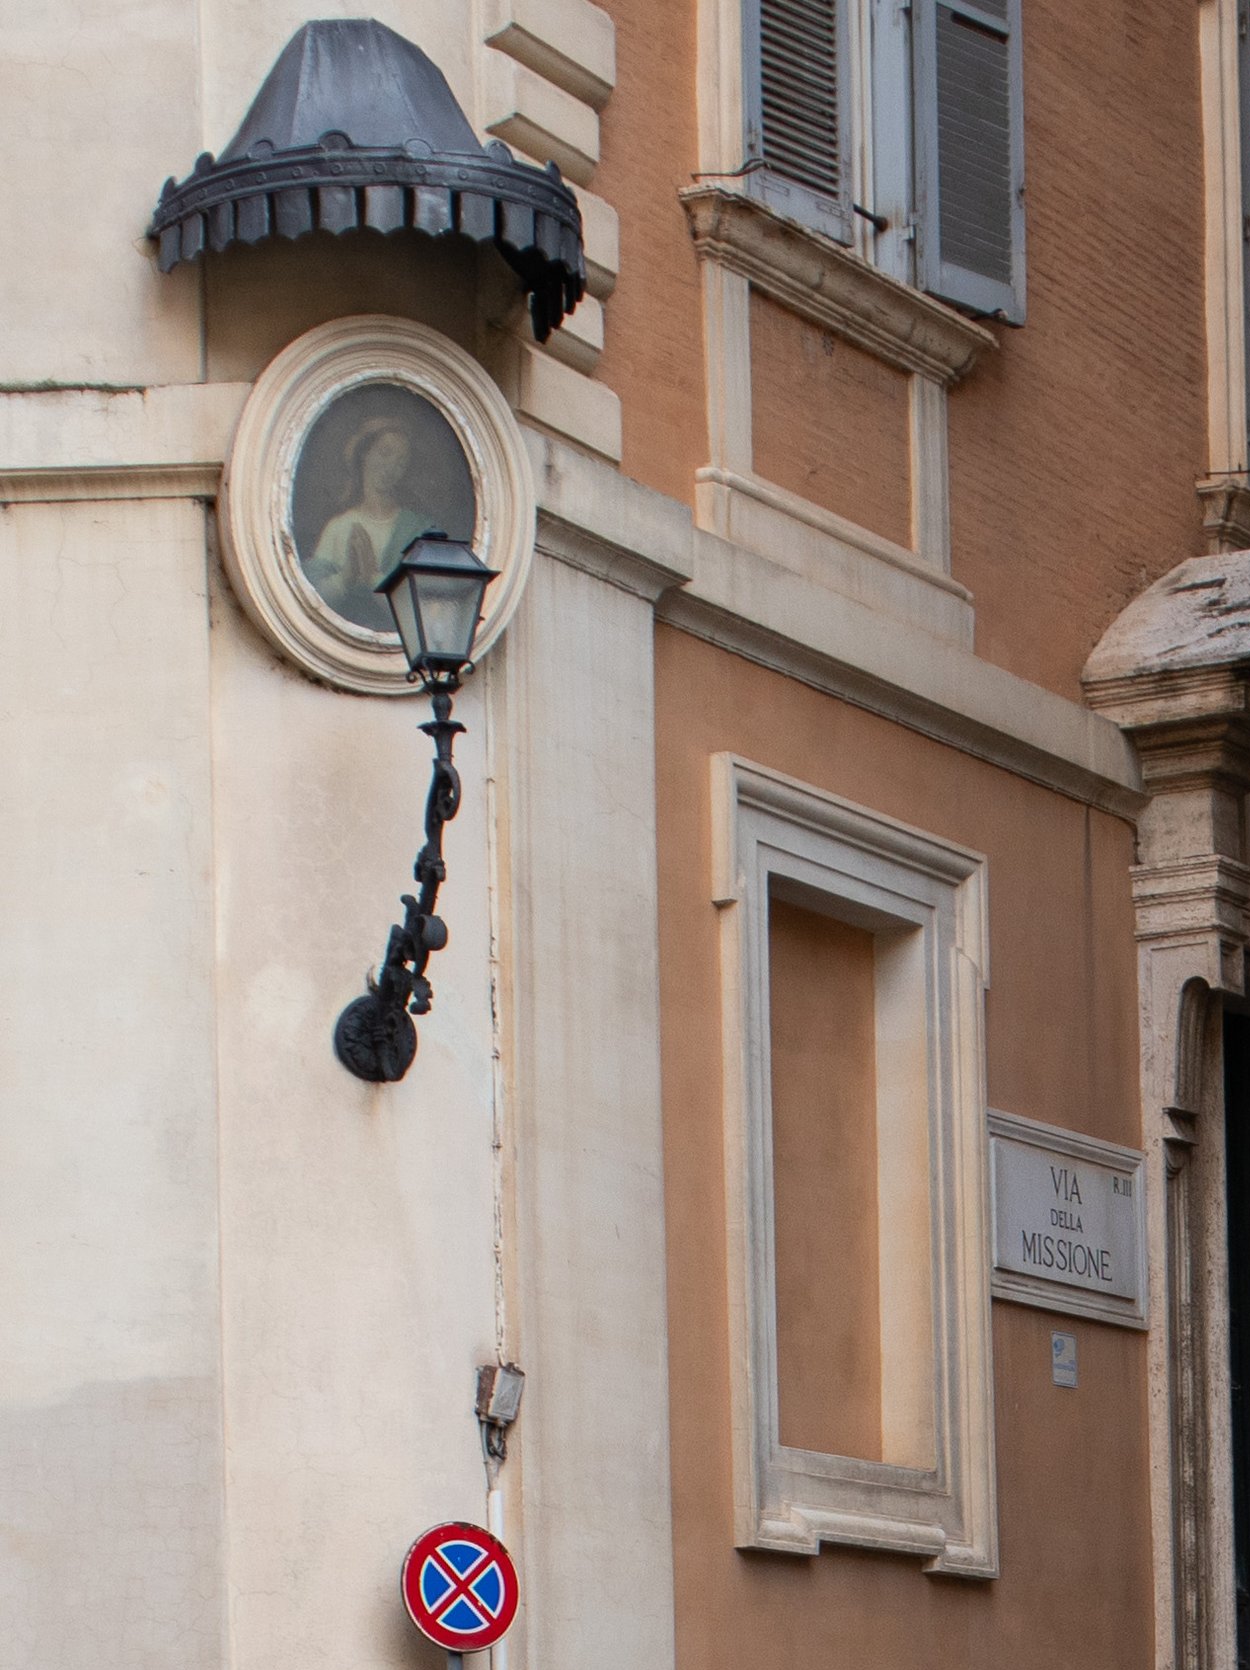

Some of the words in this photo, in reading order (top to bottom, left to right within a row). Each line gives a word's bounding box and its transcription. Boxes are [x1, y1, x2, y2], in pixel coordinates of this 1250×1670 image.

[1050, 1166, 1082, 1205] VIA
[1113, 1176, 1132, 1198] R.III
[1051, 1208, 1083, 1233] DELLA
[1021, 1230, 1113, 1282] MISSIONE
